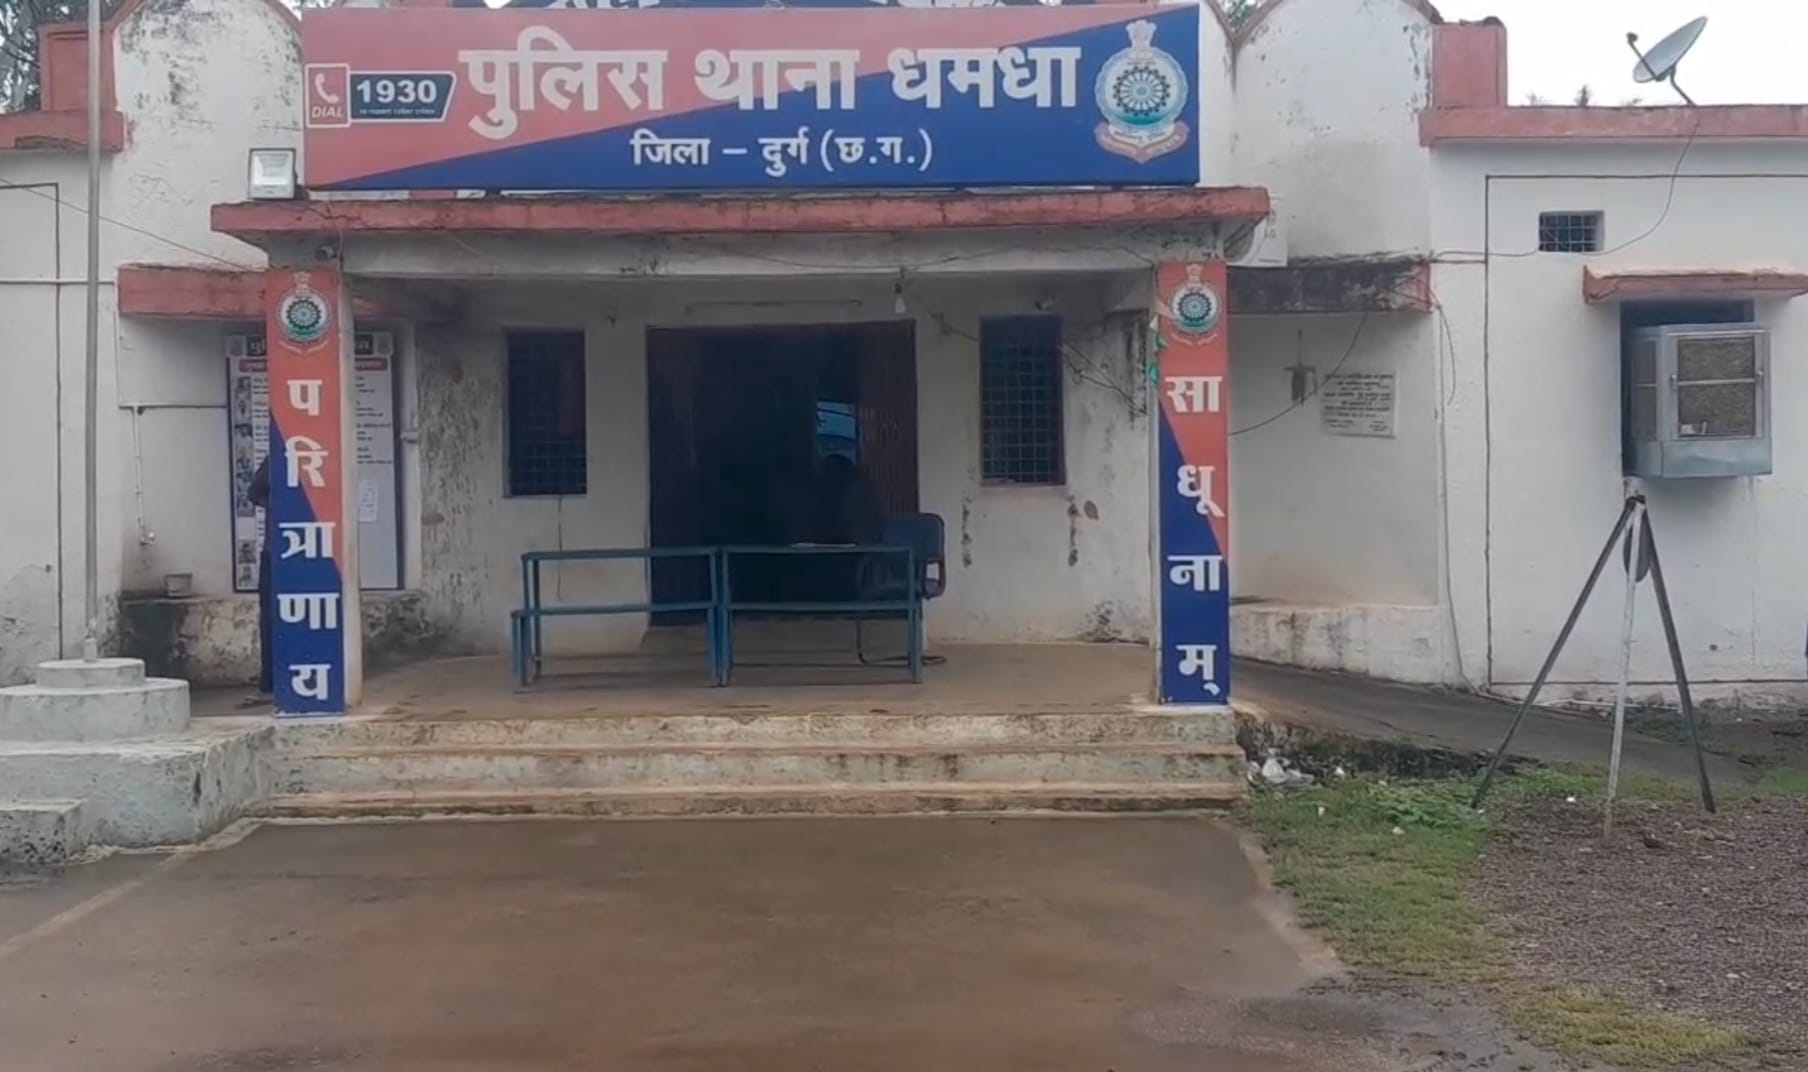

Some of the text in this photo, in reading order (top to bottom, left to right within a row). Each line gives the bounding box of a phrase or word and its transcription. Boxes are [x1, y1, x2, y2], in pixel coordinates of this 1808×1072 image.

[356, 79, 437, 103] 1930
[458, 25, 1082, 140] पुलिस थाना धमधा
[311, 105, 345, 118] DIAL
[630, 128, 711, 165] जिला
[758, 127, 809, 177] दुर्ग
[820, 129, 933, 172] (छ.ग.)
